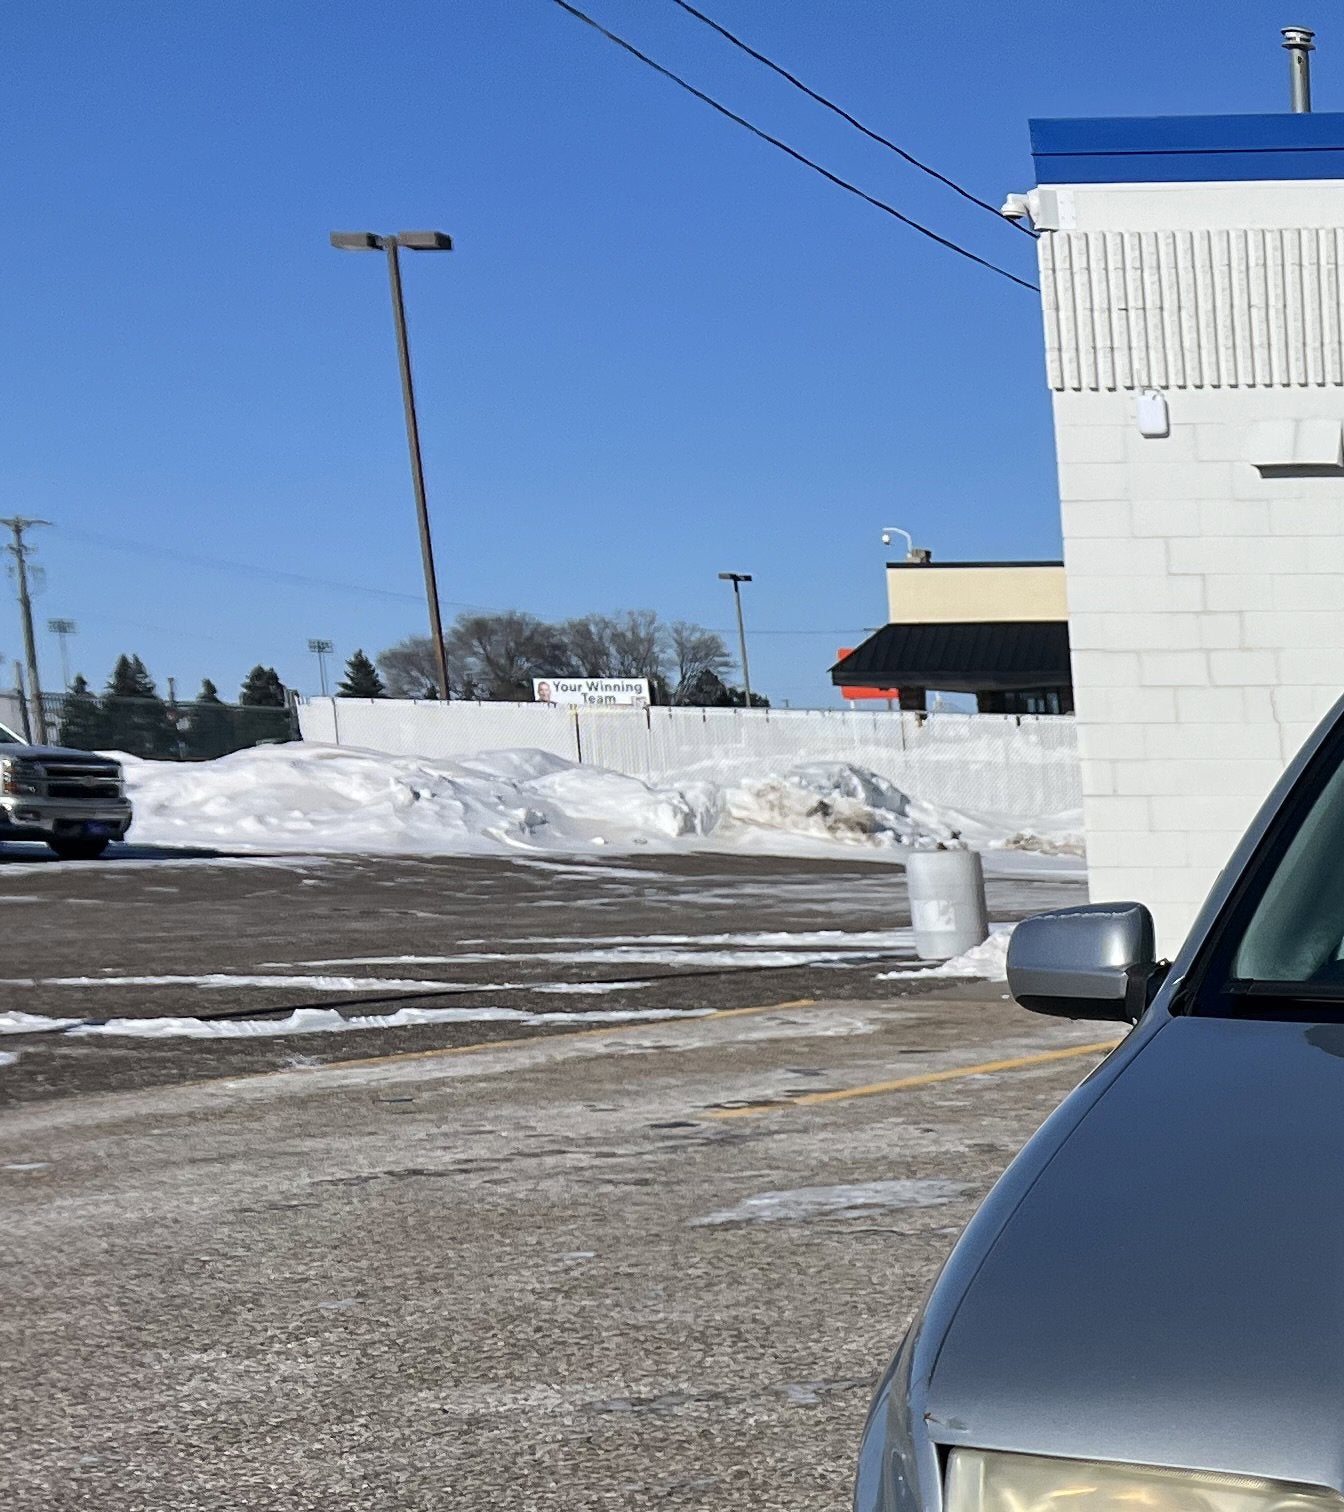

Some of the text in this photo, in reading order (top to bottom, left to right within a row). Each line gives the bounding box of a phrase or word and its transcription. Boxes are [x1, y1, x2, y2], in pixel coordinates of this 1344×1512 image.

[553, 681, 643, 694] Your Winning
[581, 692, 617, 704] Team
